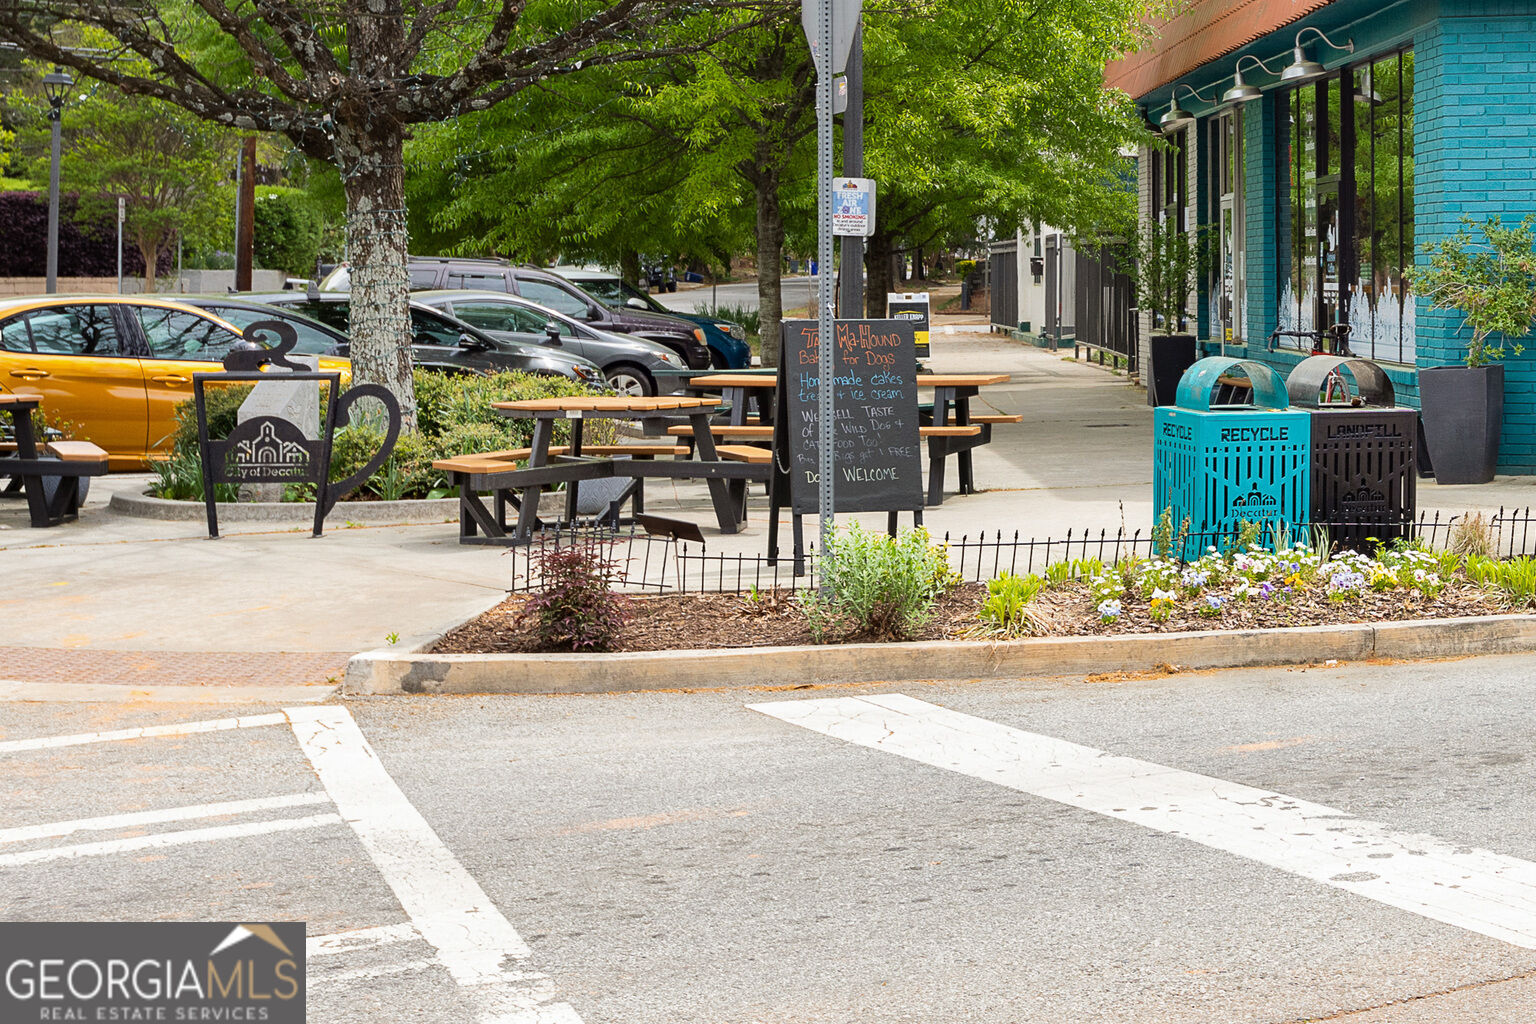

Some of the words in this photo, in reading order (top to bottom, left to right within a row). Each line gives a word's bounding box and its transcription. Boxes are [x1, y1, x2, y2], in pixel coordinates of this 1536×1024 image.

[842, 199, 858, 207] AIR
[842, 349, 860, 364] for
[865, 350, 896, 371] Dogs
[870, 370, 903, 386] cakes
[850, 387, 866, 400] ice
[871, 389, 904, 400] cream
[861, 406, 895, 417] TASTE
[841, 422, 867, 434] WILD
[1162, 422, 1192, 441] RECYCLE
[1221, 426, 1289, 442] RECYCLE
[1328, 423, 1401, 439] LANDFILL
[888, 447, 913, 456] FREE
[249, 467, 260, 476] of
[843, 465, 899, 482] WELCOME
[1231, 508, 1278, 518] Decatur
